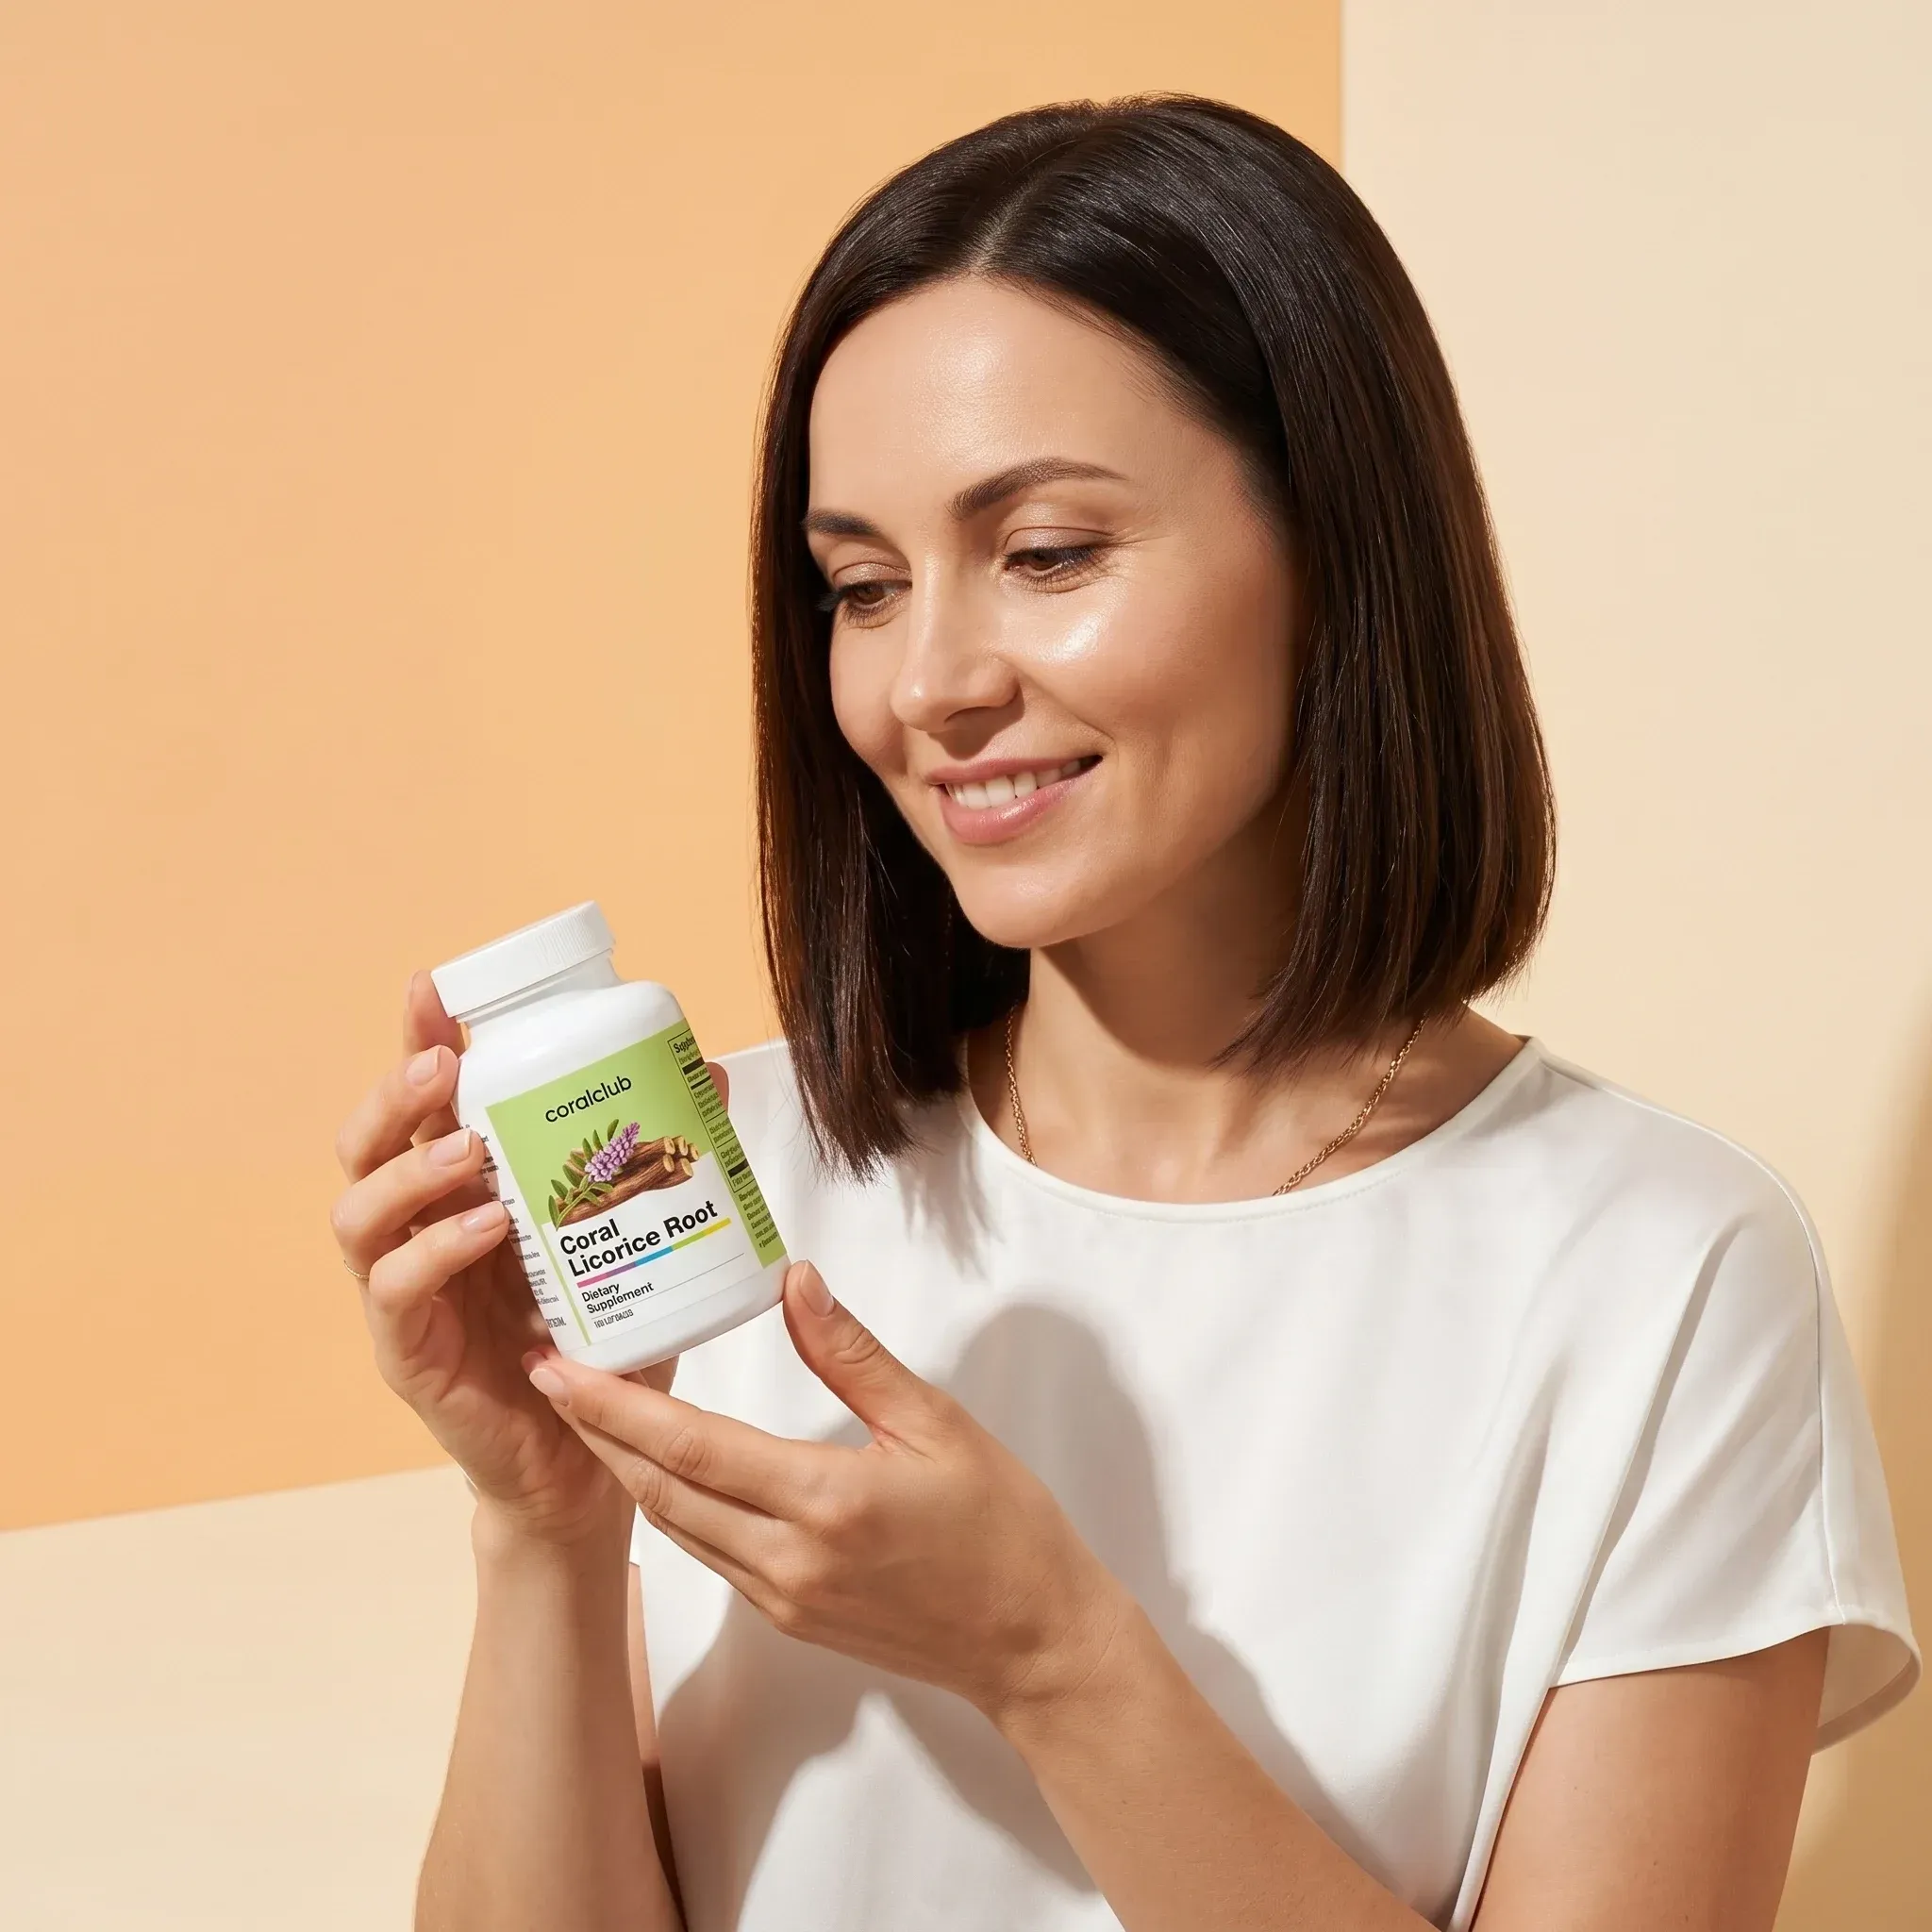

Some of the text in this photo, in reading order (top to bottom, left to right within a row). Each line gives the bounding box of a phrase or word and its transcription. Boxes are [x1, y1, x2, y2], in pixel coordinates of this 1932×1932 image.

[545, 1075, 632, 1123] coralclub
[560, 1219, 620, 1255] Coral
[568, 1230, 660, 1276] Licorice
[663, 1200, 718, 1239] Root
[582, 1283, 620, 1302] Dietary
[587, 1282, 654, 1314] Supplement
